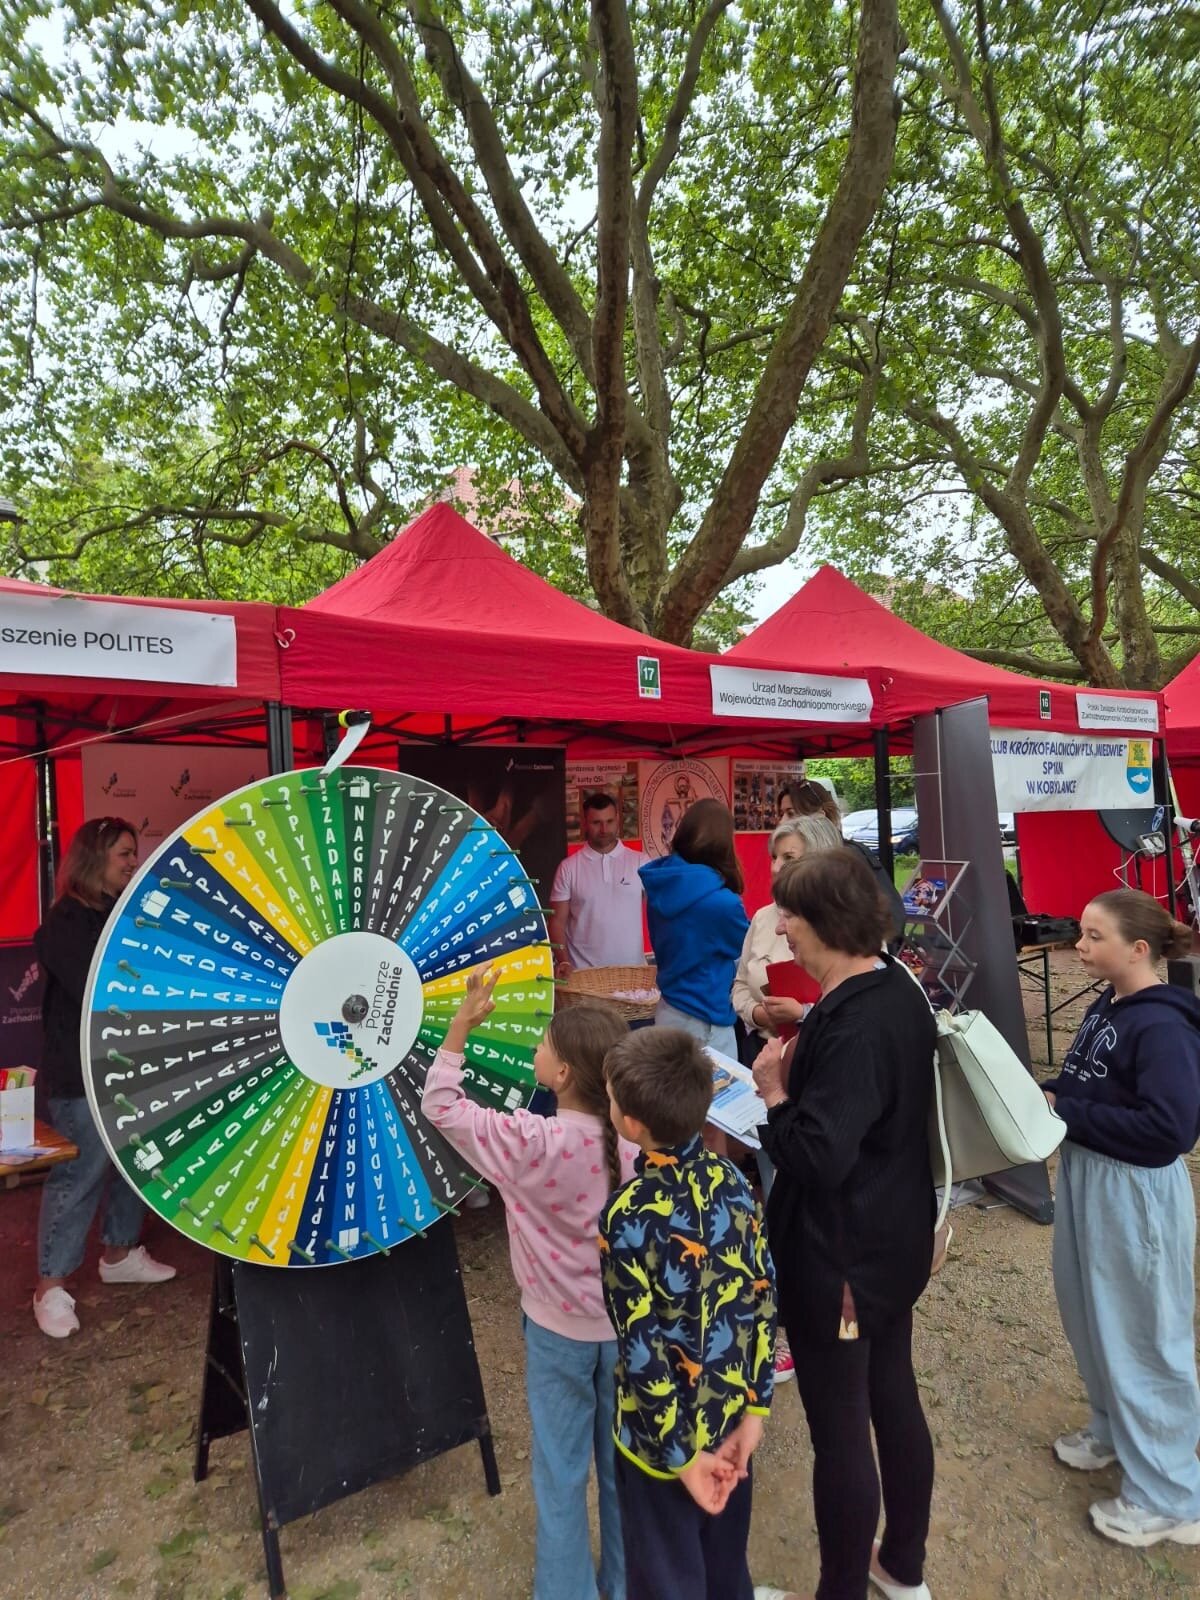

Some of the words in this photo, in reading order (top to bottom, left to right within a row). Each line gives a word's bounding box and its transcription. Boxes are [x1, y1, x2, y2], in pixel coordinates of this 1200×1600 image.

[84, 631, 174, 655] POLITES
[642, 667, 654, 681] 17
[720, 692, 776, 707] Województwa
[777, 696, 867, 712] Zachodniopomorskiego
[752, 681, 776, 694] Urząd
[777, 684, 832, 698] Marszałkowski
[1026, 780, 1036, 793] W
[224, 850, 308, 952] PYTANIE
[255, 830, 320, 942] PYTANIE
[288, 815, 334, 934] PYTANIE
[322, 807, 346, 931] ZADANIE
[352, 806, 364, 929] NAGRODA
[368, 809, 396, 930] PYTANIE
[380, 820, 424, 933] PYTANIE
[392, 834, 450, 938] PYTANIE
[402, 854, 474, 946] PYTANIE
[171, 908, 290, 976] NAGRODA
[195, 877, 298, 962] PYTANIE
[410, 876, 492, 956] ZADANIE
[418, 902, 508, 968] NAGRODA
[422, 929, 518, 980] PYTANIE
[142, 984, 278, 1005] PYTANIE
[154, 944, 283, 990] ZADANIE
[366, 960, 390, 1030] Pomorze
[376, 966, 402, 1046] Zachodnie
[138, 1014, 276, 1036] PYTANIE
[140, 1028, 277, 1076] PYTANIE
[150, 1042, 282, 1112] PYTANIE
[165, 1056, 288, 1148] NAGRODA
[186, 1068, 294, 1175] ZADANIE
[215, 1078, 304, 1198] PYTANIE
[245, 1085, 316, 1213] PYTANIE
[278, 1090, 329, 1224] PYTANIE
[312, 1092, 342, 1224] PYTANIE
[345, 1092, 356, 1221] NAGRODA
[364, 1088, 386, 1210] ZADANIE
[376, 1084, 416, 1195] PYTANIE
[388, 1075, 444, 1175] PYTANIE
